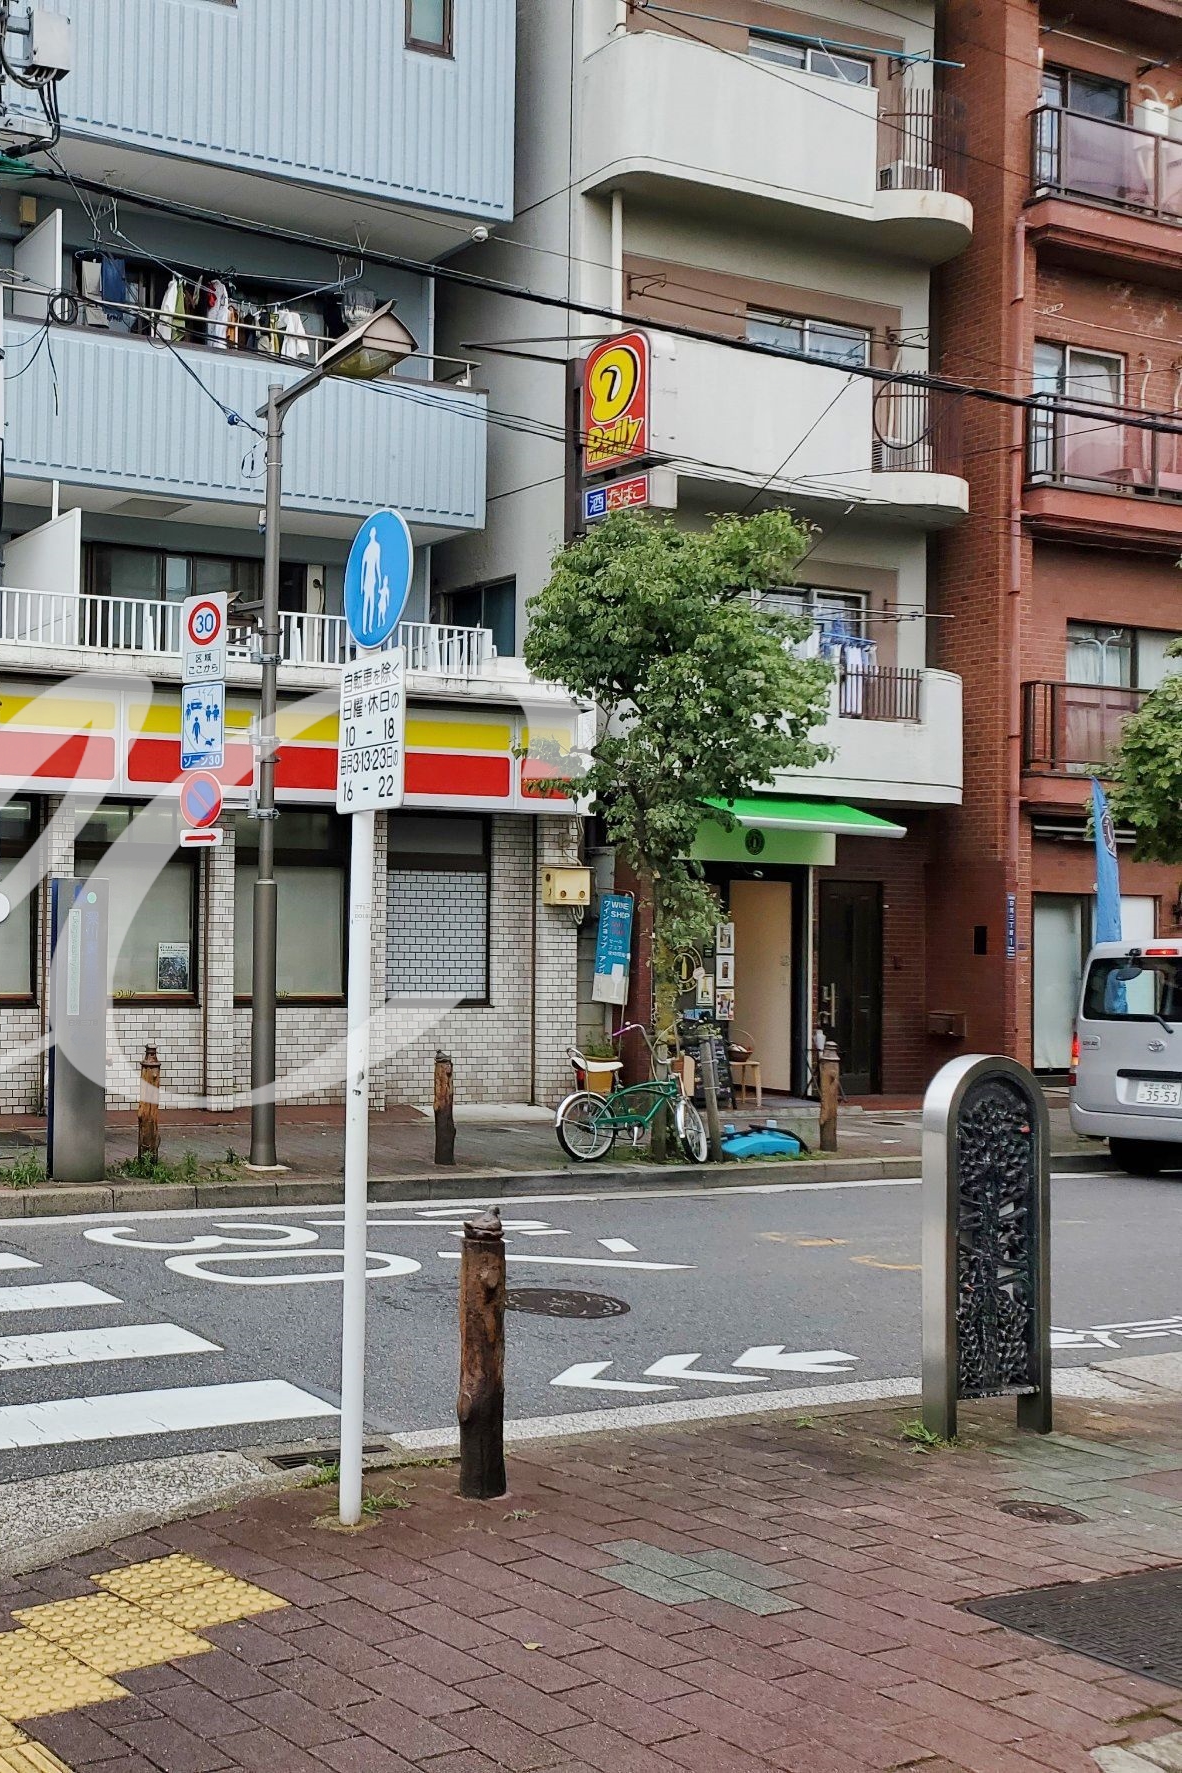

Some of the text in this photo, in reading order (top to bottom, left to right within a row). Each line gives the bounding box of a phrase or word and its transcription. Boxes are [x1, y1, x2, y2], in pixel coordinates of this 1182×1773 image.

[588, 417, 643, 453] Daily
[589, 495, 604, 514] 酒
[608, 481, 645, 509] たばこ
[195, 613, 215, 634] 30
[195, 653, 213, 664] 区域
[188, 664, 219, 676] ここから
[344, 661, 400, 694] 自転車を除く
[345, 726, 356, 747] 10
[383, 717, 395, 740] 18
[184, 753, 221, 768] ゾーン30
[343, 779, 354, 802] 16
[378, 774, 394, 797] 22
[601, 900, 611, 949] ワインショップ
[610, 911, 630, 919] SHOP
[1145, 1090, 1178, 1103] 35-53
